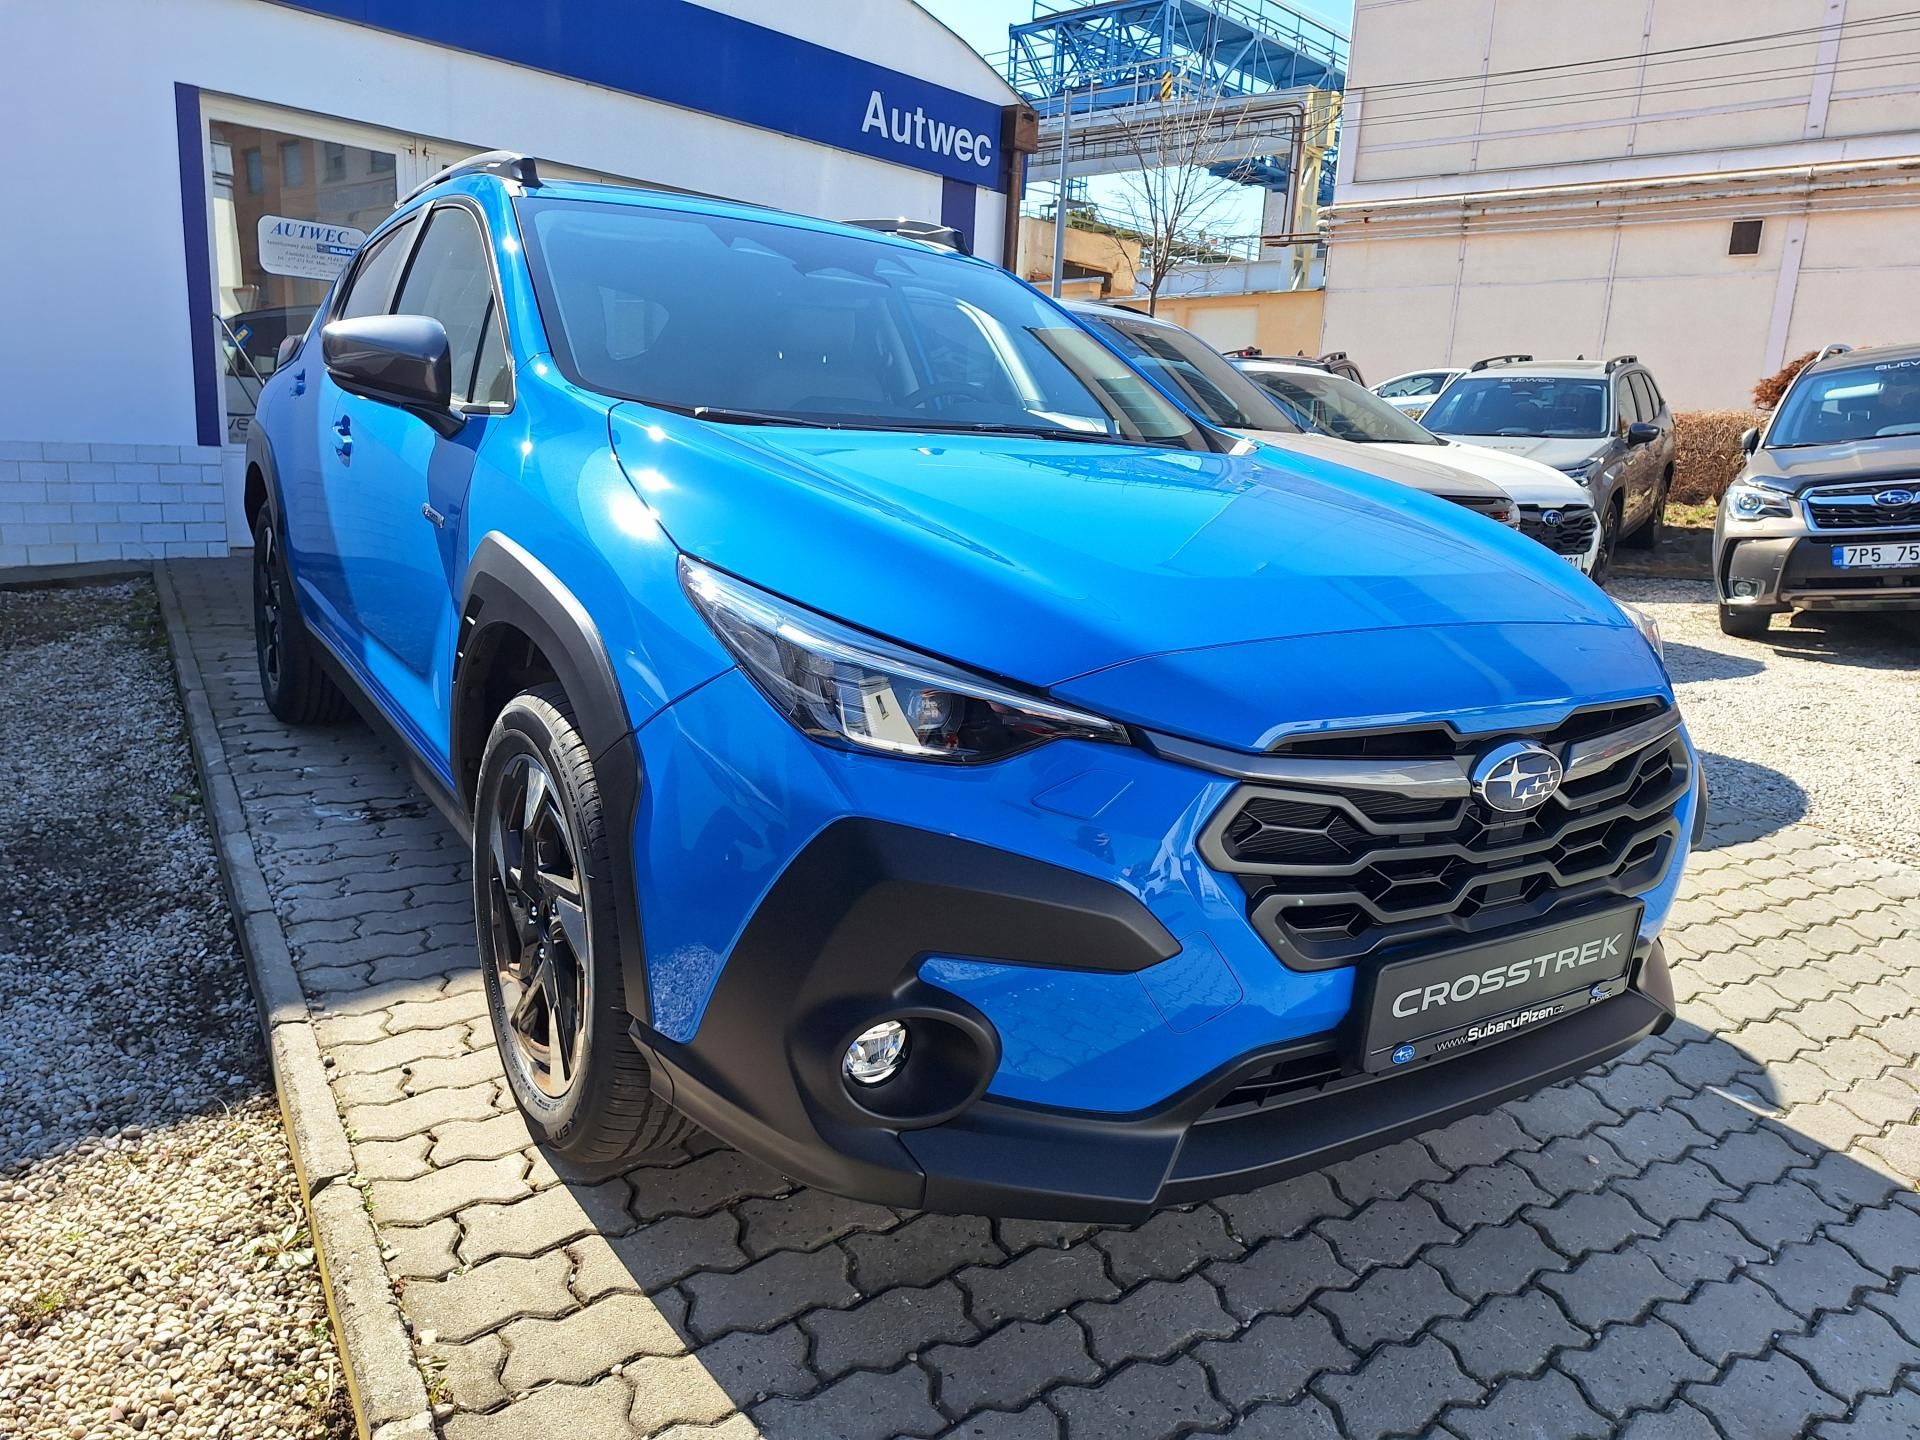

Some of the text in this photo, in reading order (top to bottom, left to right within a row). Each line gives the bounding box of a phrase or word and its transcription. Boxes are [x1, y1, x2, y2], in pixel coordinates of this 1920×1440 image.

[861, 90, 992, 167] Autwec
[270, 221, 350, 244] AUTWEC
[1847, 545, 1920, 564] 7P5 75
[1392, 933, 1623, 1019] CROSSTREK
[1436, 1005, 1565, 1052] www.SubaruPlzen.cz
